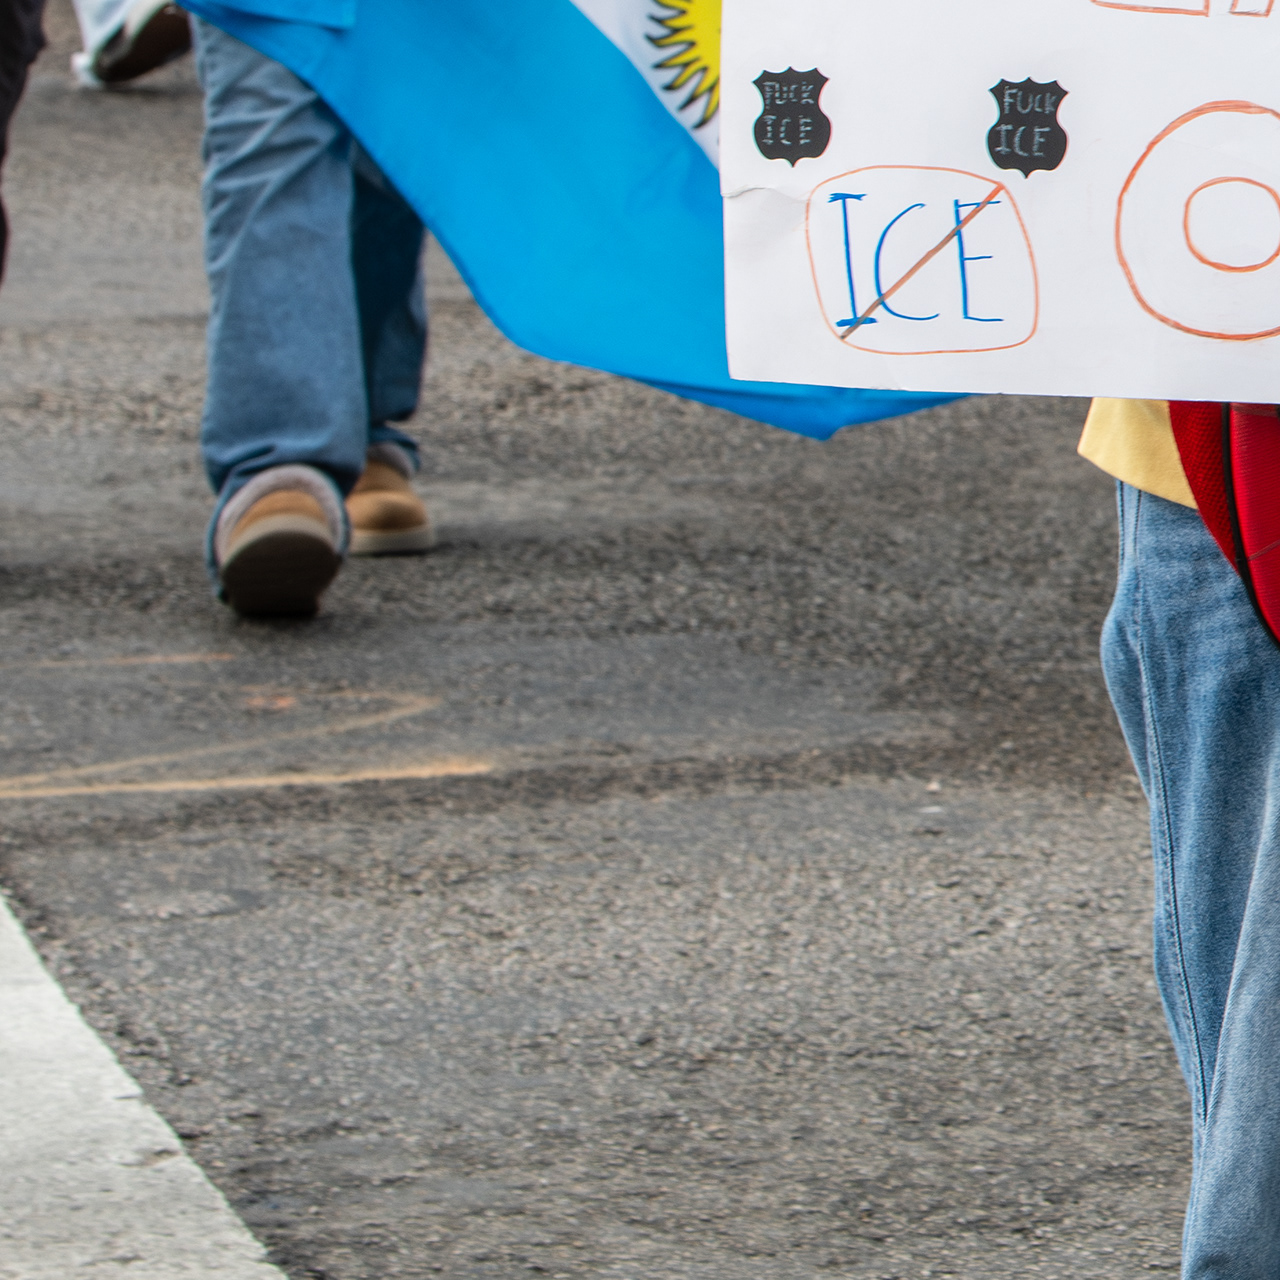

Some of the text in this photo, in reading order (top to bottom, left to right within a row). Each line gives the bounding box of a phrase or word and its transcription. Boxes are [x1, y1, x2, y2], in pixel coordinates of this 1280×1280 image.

[1003, 85, 1058, 115] FUCK
[994, 123, 1052, 157] ICE
[827, 192, 1004, 328] ICE
